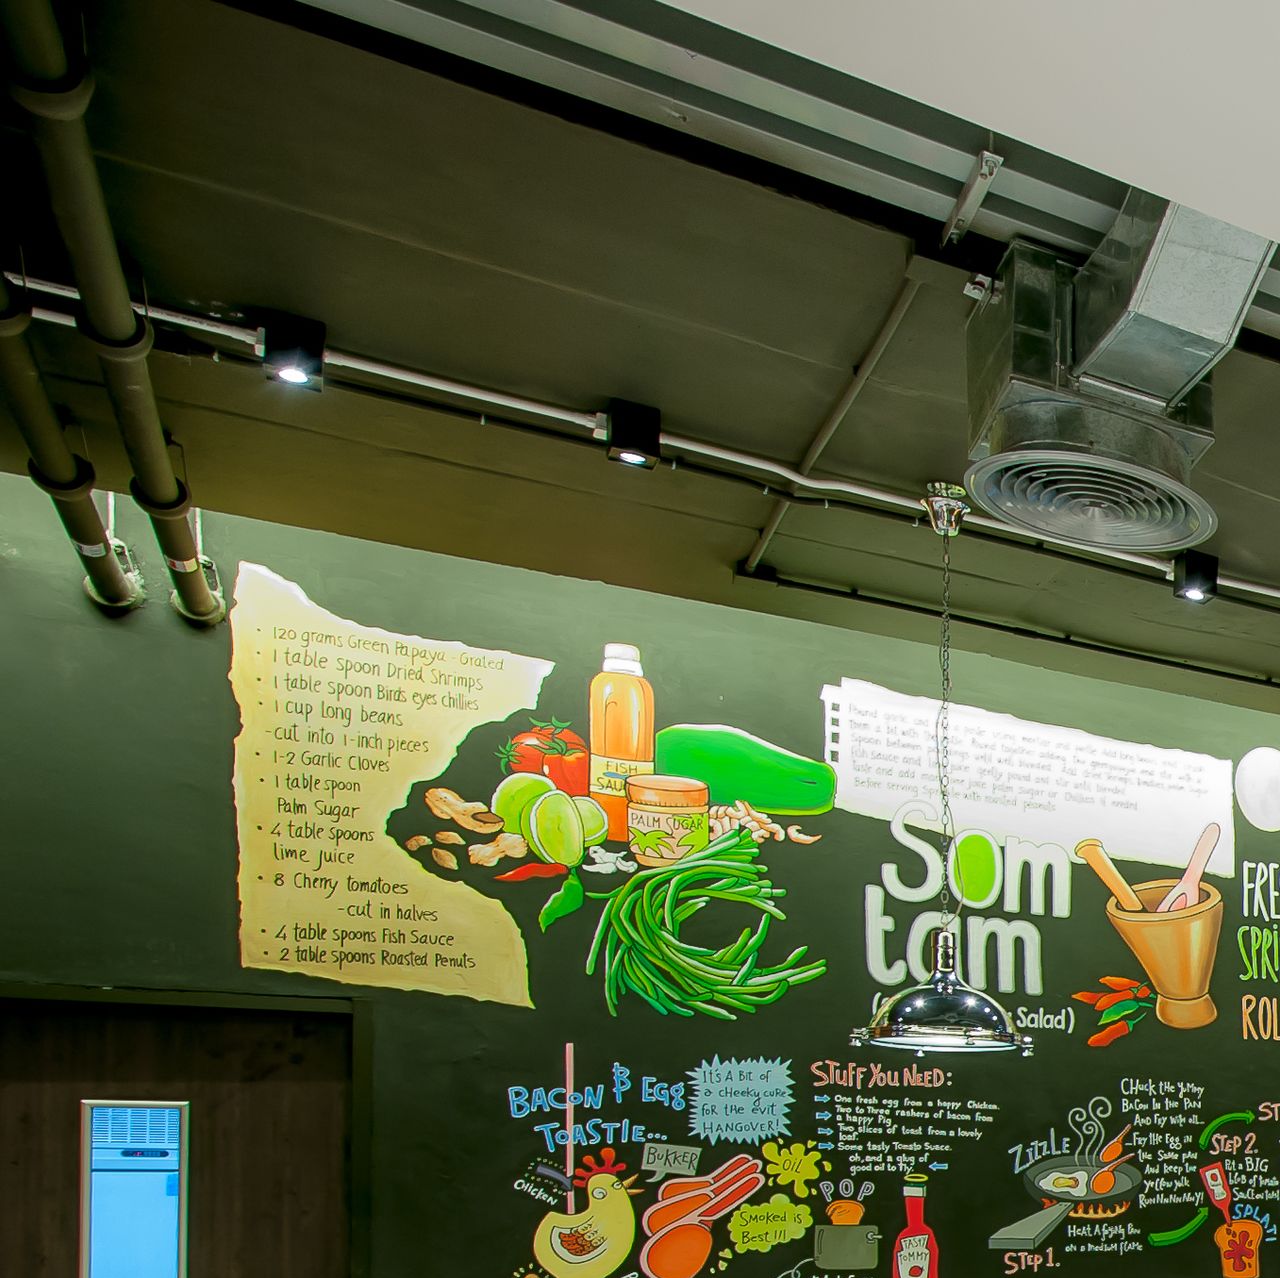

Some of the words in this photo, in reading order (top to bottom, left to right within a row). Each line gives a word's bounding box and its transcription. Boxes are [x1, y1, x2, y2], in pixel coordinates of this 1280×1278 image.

[273, 626, 297, 640] 120
[301, 630, 343, 648] grams
[348, 635, 389, 655] Green
[395, 640, 447, 666] Papaya
[284, 650, 329, 669] table
[336, 656, 380, 679] spoon
[387, 662, 425, 683] Dried
[431, 668, 484, 693] Shrimps
[284, 673, 321, 693] table
[327, 680, 372, 702] spoon
[377, 684, 407, 703] Birds
[412, 690, 437, 710] eyes
[441, 691, 479, 711] chillies
[286, 700, 313, 722] cup
[360, 706, 403, 727] beans
[307, 726, 334, 745] into
[388, 737, 429, 757] pieces
[301, 750, 342, 769] Garlic
[348, 755, 390, 772] Cloves
[605, 760, 638, 774] FISH
[286, 773, 320, 792] table
[324, 778, 361, 799] spoon
[277, 797, 307, 816] Palm
[314, 800, 361, 823] Sugar
[631, 813, 662, 829] PALM
[666, 815, 704, 833] SUGAR
[270, 823, 281, 837] 4
[288, 820, 324, 839] table
[328, 825, 375, 847] spoons
[273, 841, 310, 863] lime
[313, 849, 355, 872] juice
[882, 799, 1072, 918] Som
[273, 873, 285, 887] 8
[294, 872, 339, 899] Cherry
[347, 874, 409, 895] tomatoes
[380, 902, 391, 920] in
[396, 904, 438, 922] halves
[275, 924, 287, 941] 4
[293, 922, 327, 942] table
[332, 928, 377, 947] spoons
[382, 928, 406, 944] Fish
[410, 930, 455, 946] Sauce
[279, 948, 290, 962] 2
[295, 946, 327, 964] table
[331, 949, 376, 970] spoons
[381, 950, 428, 967] Roasted
[435, 952, 477, 969] Penuts
[758, 1070, 773, 1084] of
[508, 1085, 604, 1118] BACON
[1245, 1157, 1269, 1172] BIG
[741, 1231, 771, 1245] Best
